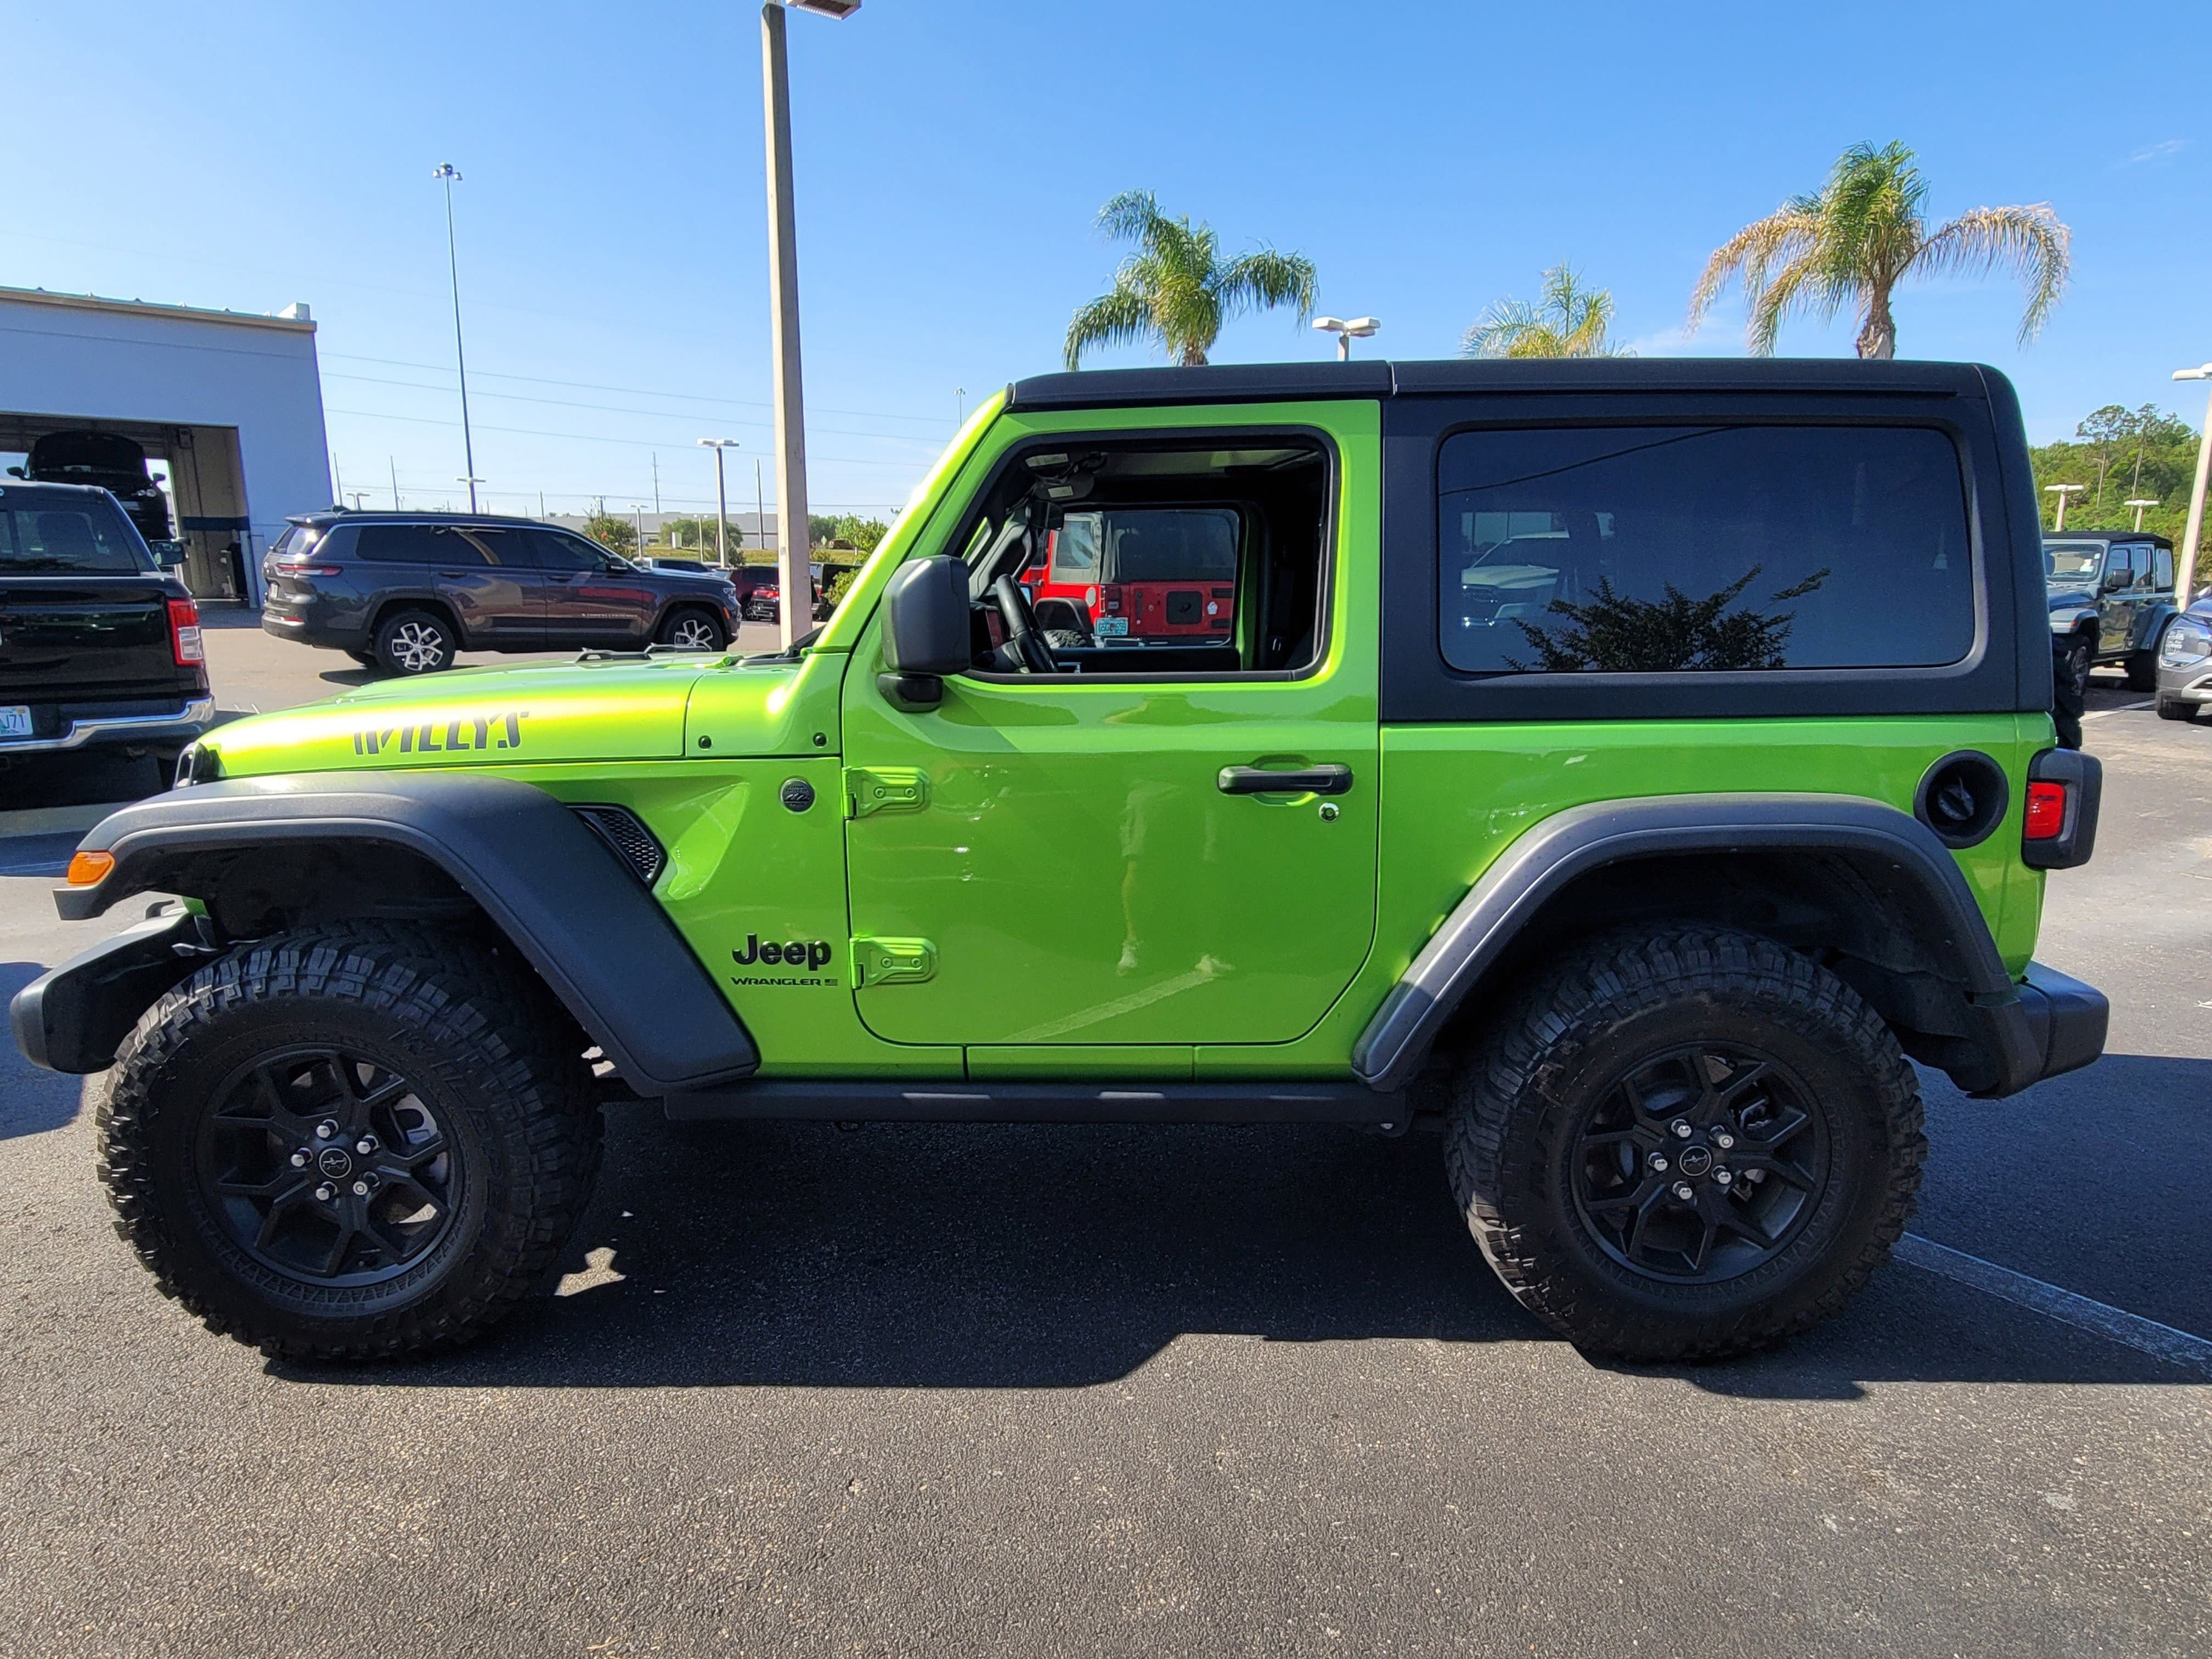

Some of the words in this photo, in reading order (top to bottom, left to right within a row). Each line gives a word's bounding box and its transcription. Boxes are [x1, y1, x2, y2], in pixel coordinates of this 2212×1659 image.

[354, 711, 529, 755] WILLYS
[732, 933, 832, 971] Jeep
[731, 977, 821, 986] WRANGLER
